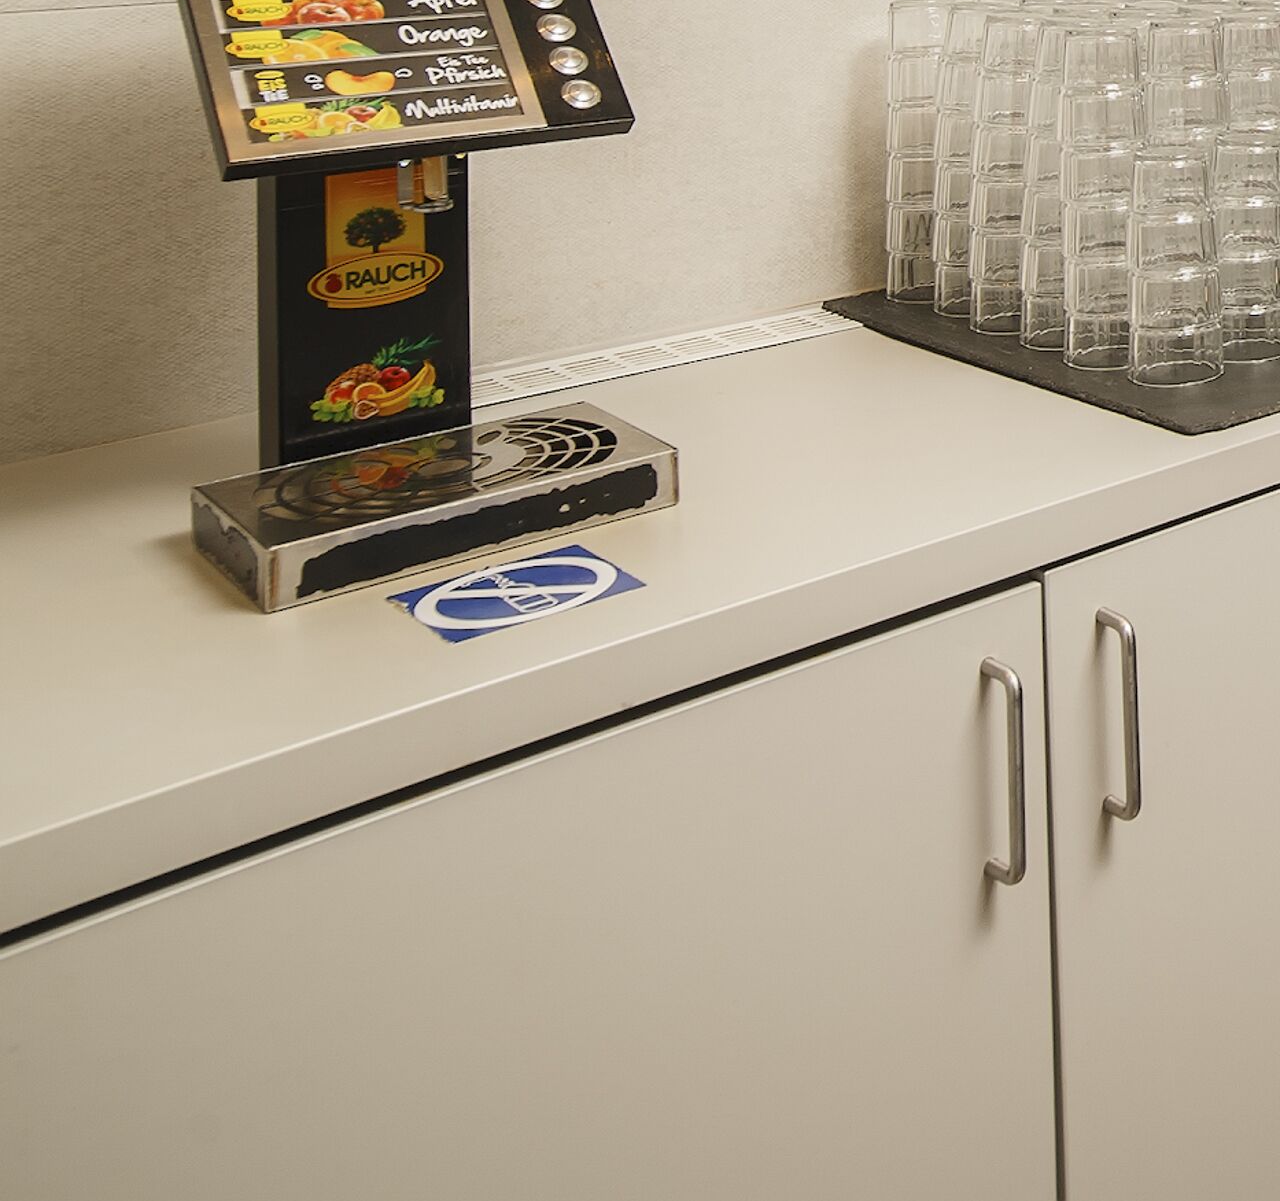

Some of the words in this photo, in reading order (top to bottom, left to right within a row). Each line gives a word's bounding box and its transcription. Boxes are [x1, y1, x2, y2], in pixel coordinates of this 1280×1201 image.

[245, 6, 284, 15] RAUCH
[398, 24, 488, 47] Orange
[244, 41, 284, 51] RAUCH
[460, 54, 489, 65] Tee
[425, 64, 507, 85] Pfirsich
[258, 78, 287, 92] EIS
[268, 114, 308, 126] RAUCH
[345, 260, 427, 290] RAUCH
